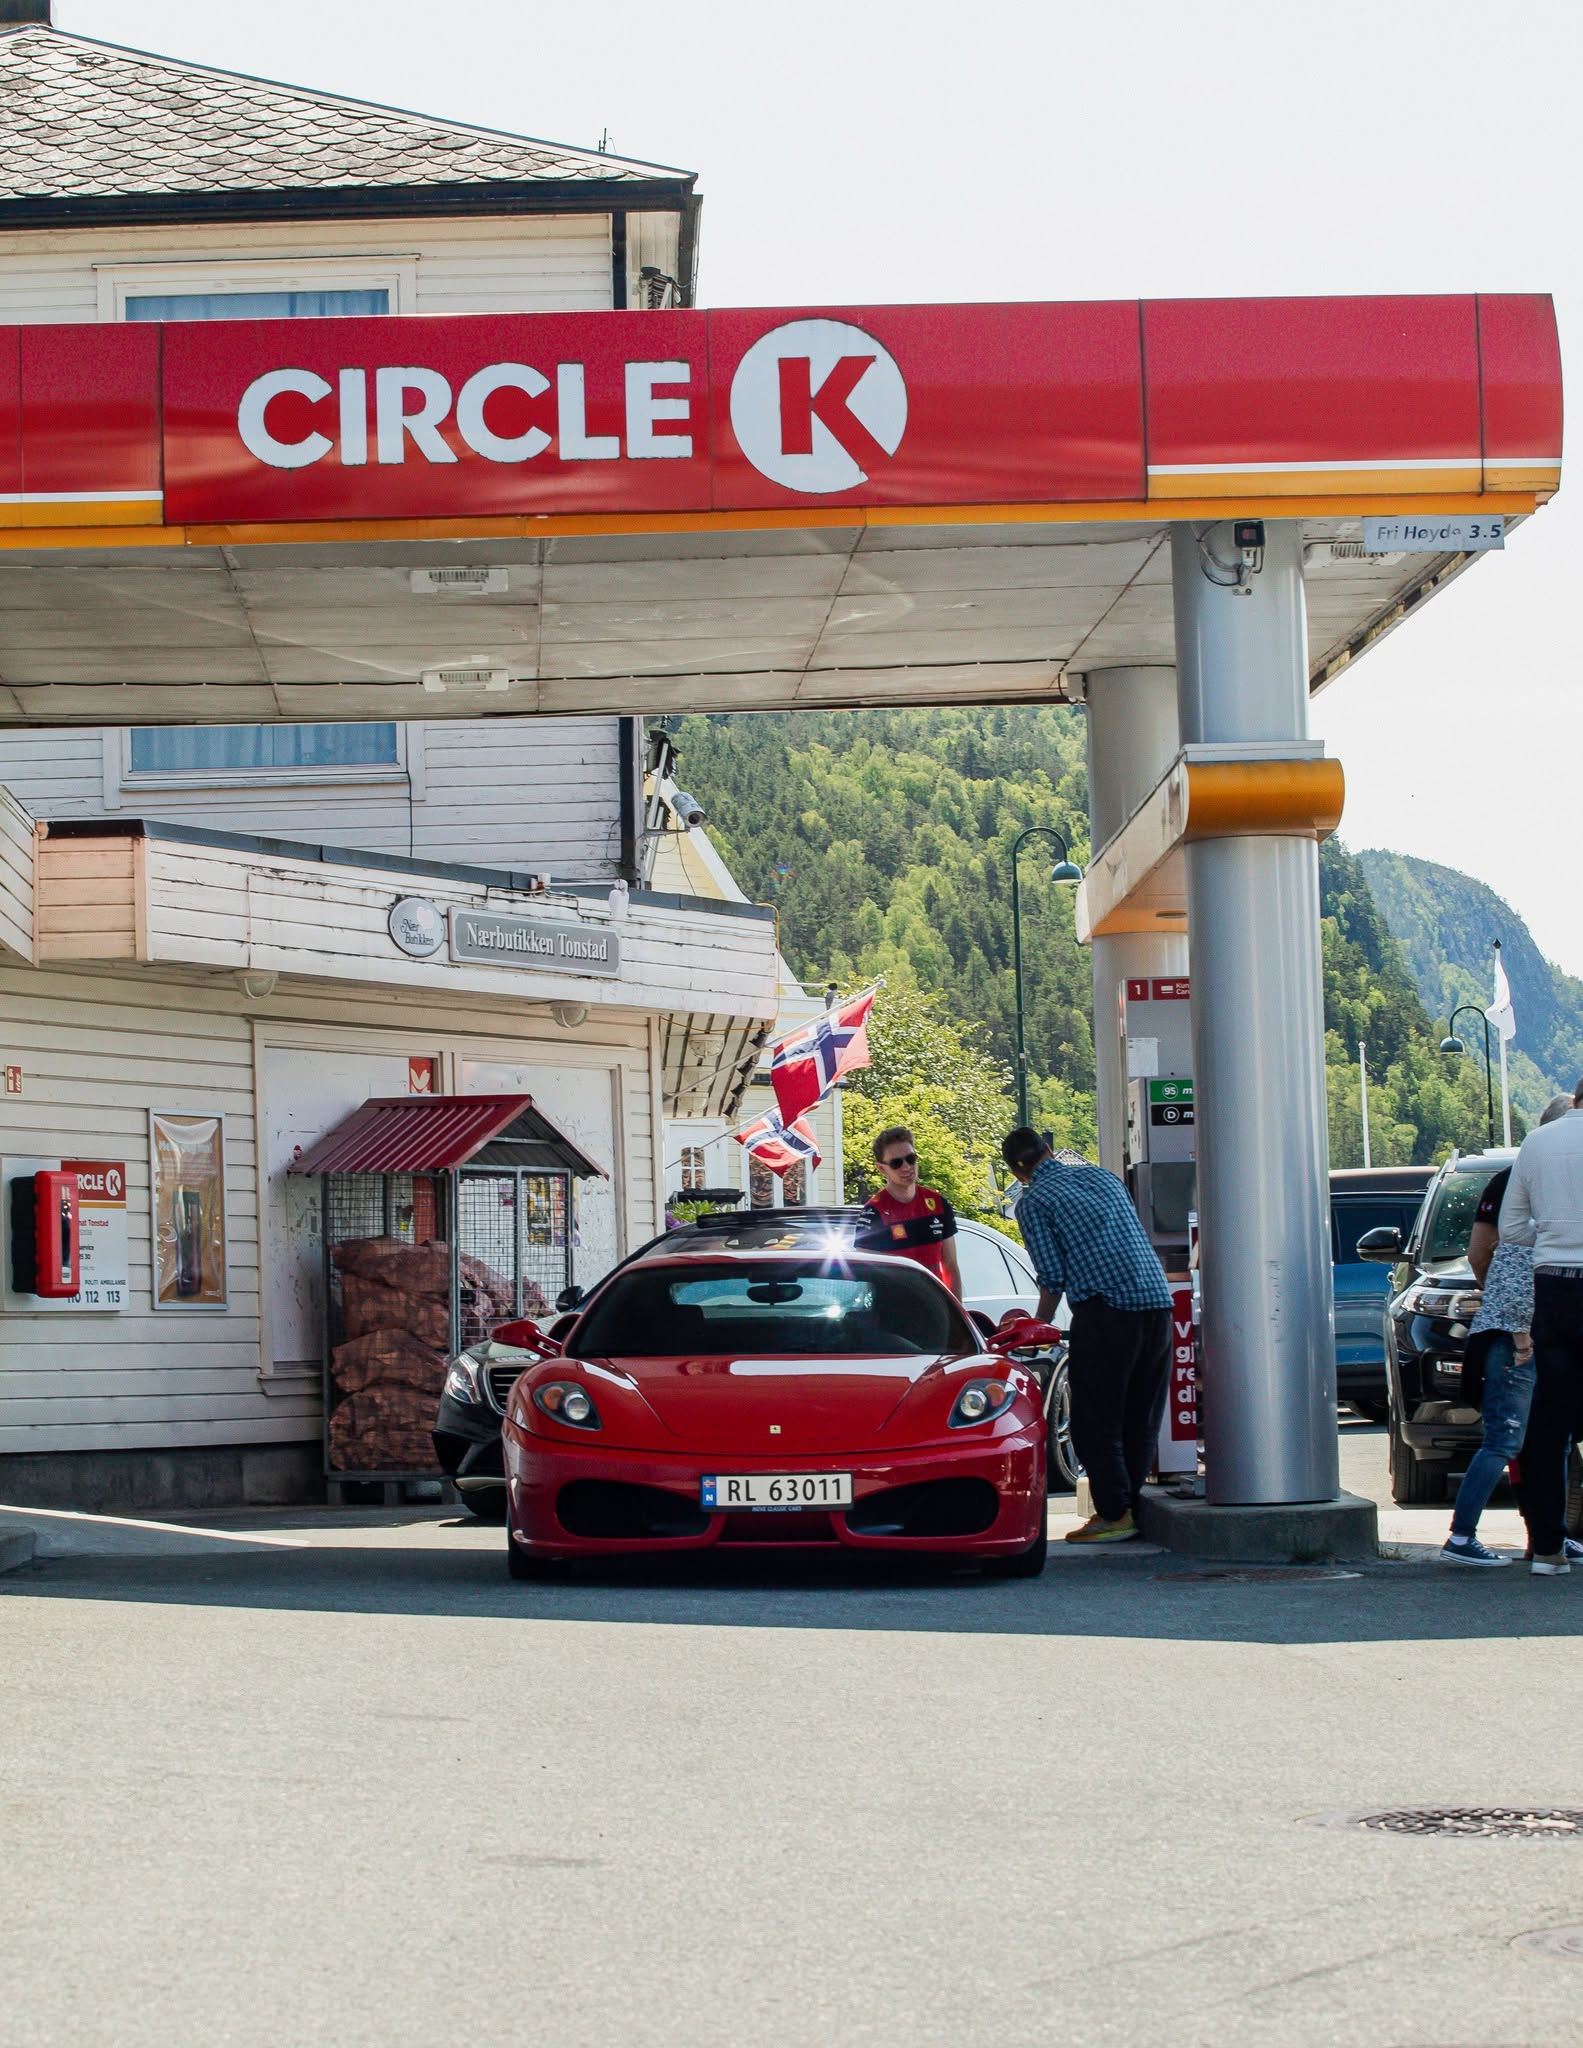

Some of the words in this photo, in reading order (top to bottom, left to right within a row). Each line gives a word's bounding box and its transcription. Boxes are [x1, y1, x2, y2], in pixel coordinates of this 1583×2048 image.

[237, 360, 693, 469] CIRCLE
[1377, 525, 1399, 541] Fri
[1468, 524, 1502, 539] 3.5
[401, 918, 420, 933] Nær
[465, 921, 556, 956] Nærbutikken
[556, 932, 609, 962] Tonstad
[1134, 984, 1142, 996] 1
[1163, 1086, 1177, 1096] 95
[1167, 1110, 1177, 1120] D
[75, 1173, 105, 1191] RCLE
[85, 1290, 99, 1304] 112
[106, 1290, 121, 1304] 113
[727, 1479, 757, 1502] RL
[769, 1478, 842, 1502] 63011
